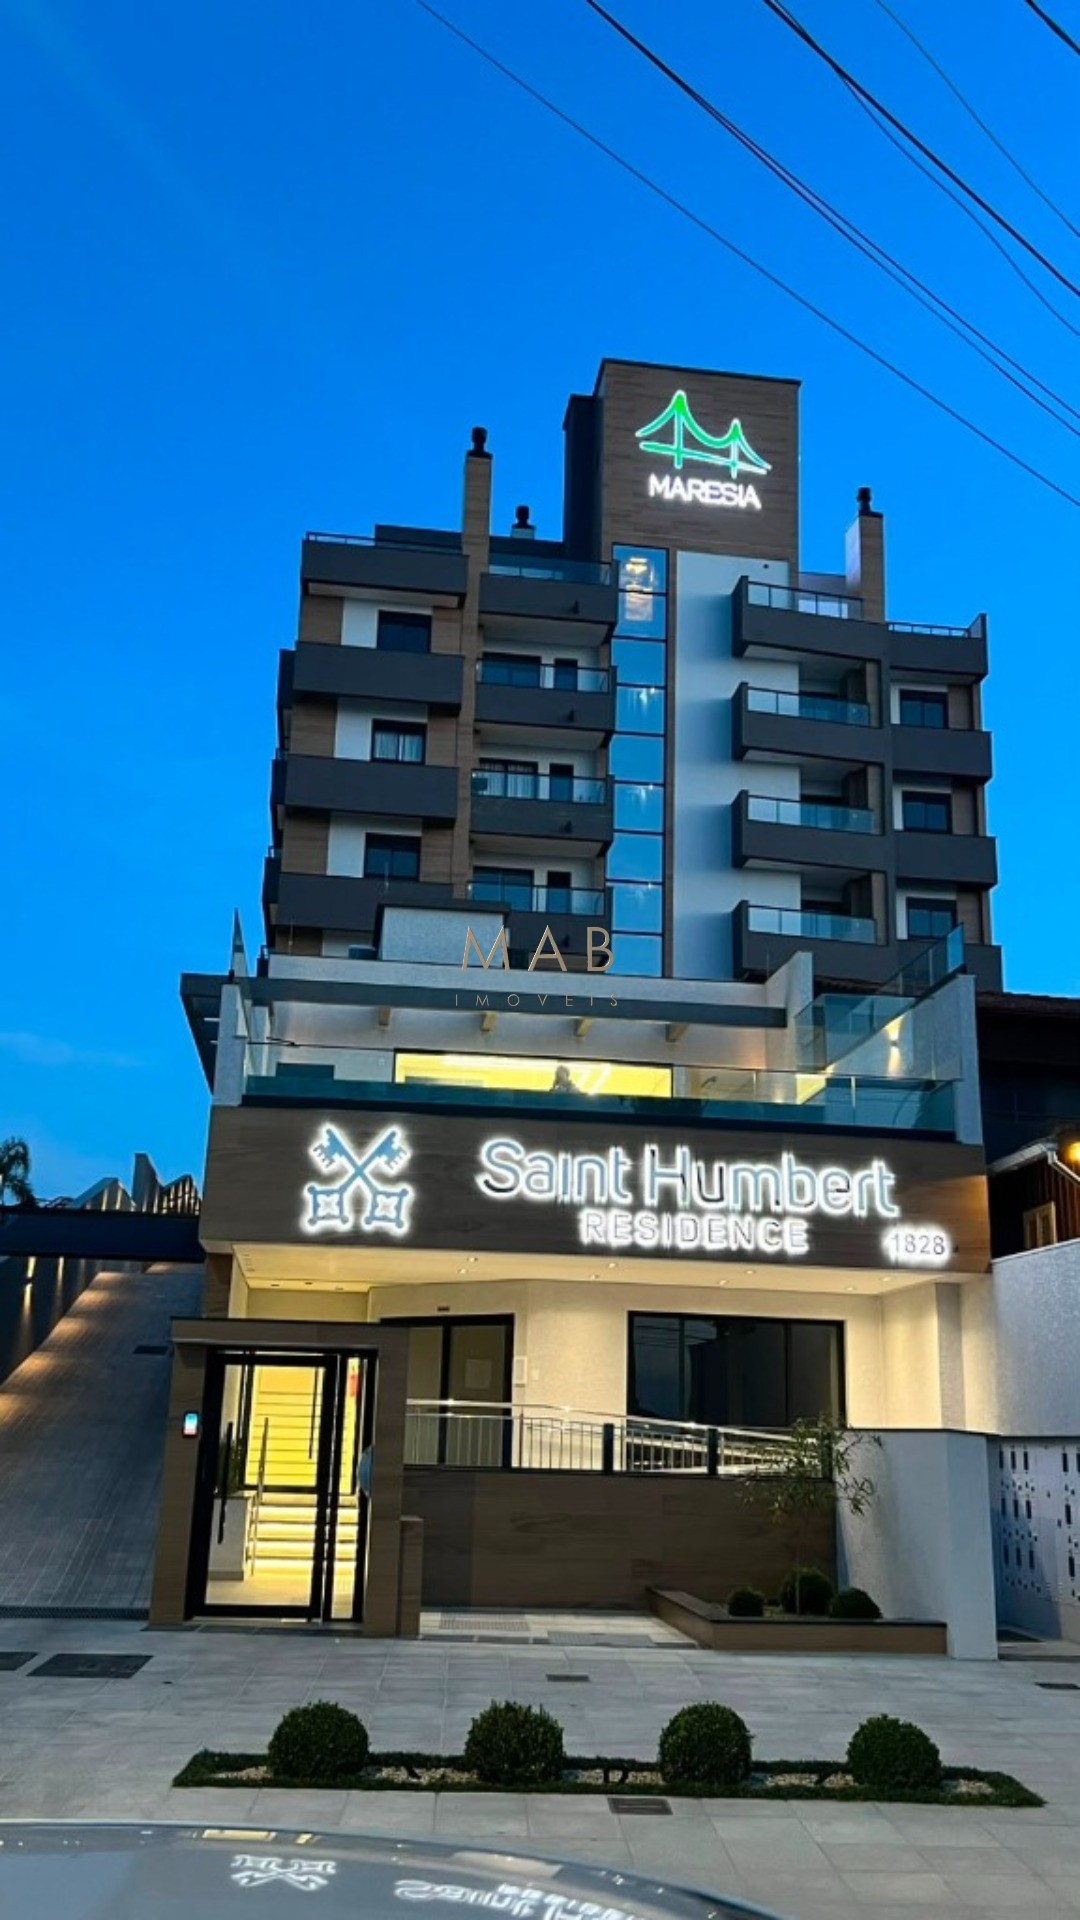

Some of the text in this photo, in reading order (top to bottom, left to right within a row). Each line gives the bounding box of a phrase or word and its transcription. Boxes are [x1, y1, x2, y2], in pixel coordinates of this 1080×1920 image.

[650, 473, 762, 509] MARESIA
[476, 1138, 900, 1218] Saint Humbert
[579, 1208, 809, 1254] RESIDENCE
[884, 1228, 949, 1261] 1828
